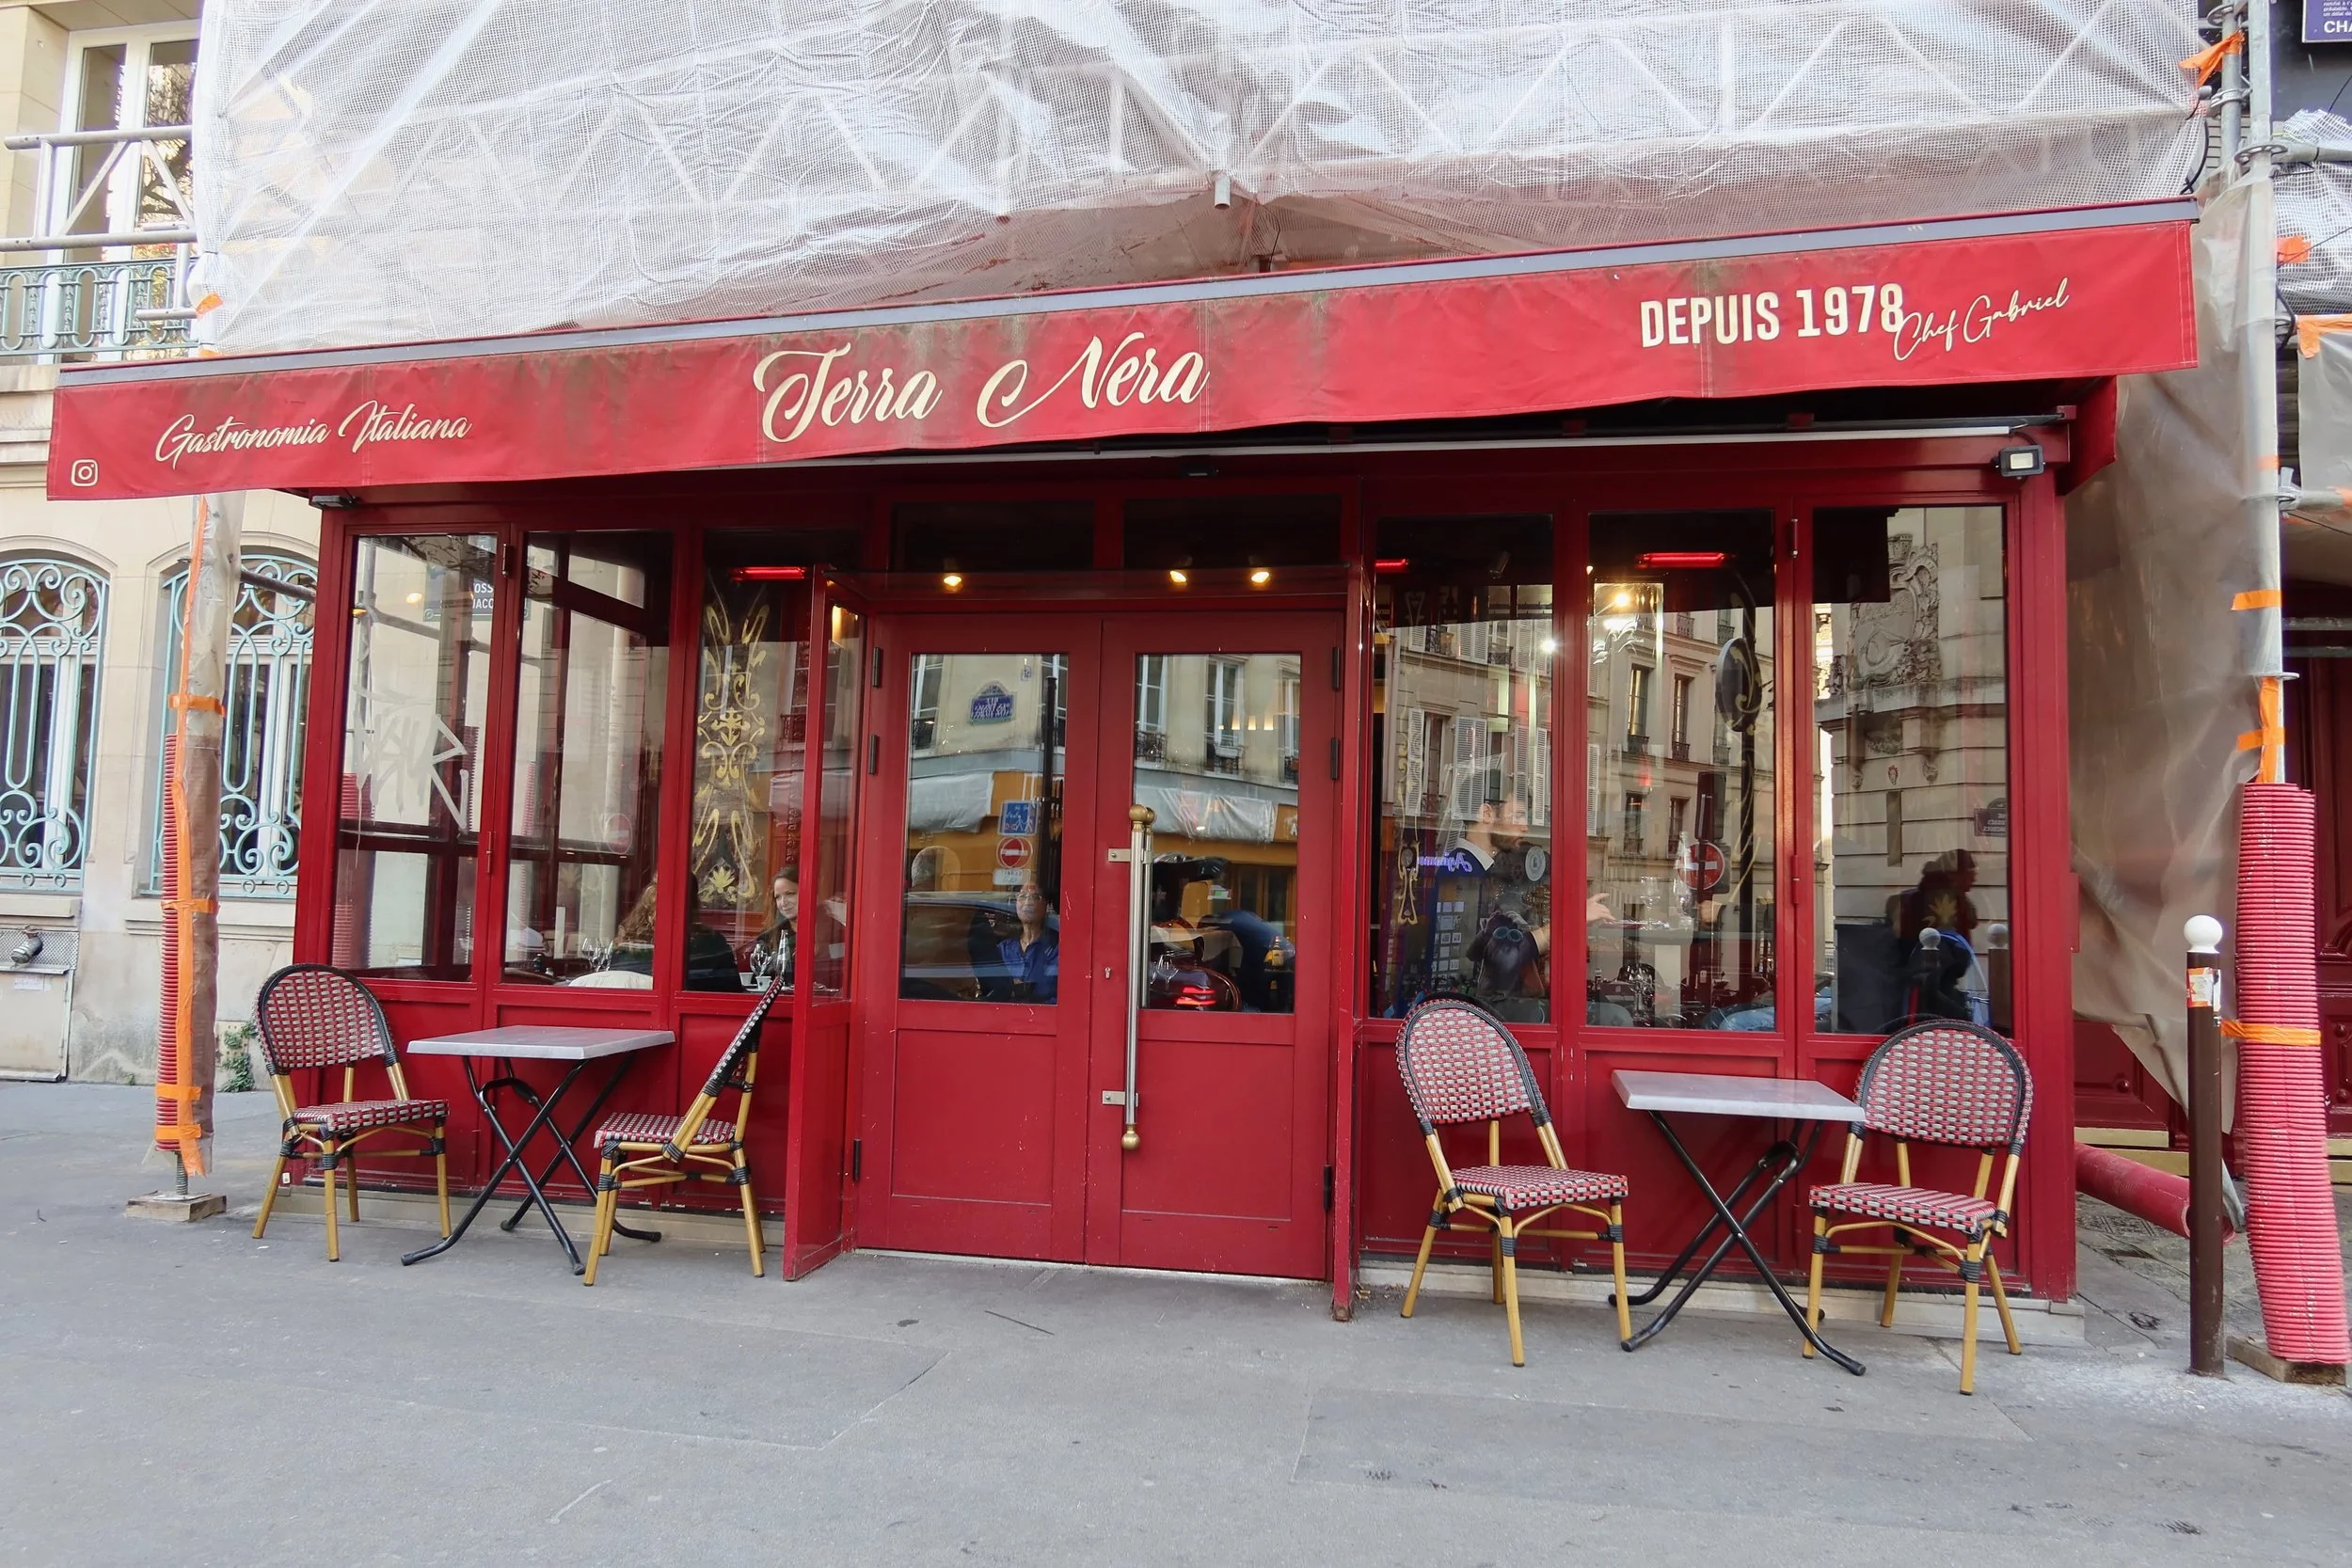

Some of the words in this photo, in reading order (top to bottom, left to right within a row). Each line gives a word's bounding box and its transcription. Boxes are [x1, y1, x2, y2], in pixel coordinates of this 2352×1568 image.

[1640, 291, 1781, 349] DEPUIS
[1795, 282, 1904, 339] 1978
[1893, 309, 1960, 361] Chef
[1963, 277, 2070, 343] Gabriel
[753, 342, 944, 443] Terra
[976, 331, 1211, 429] Nera
[154, 413, 331, 470] Gastronomia
[338, 399, 472, 453] Italiana
